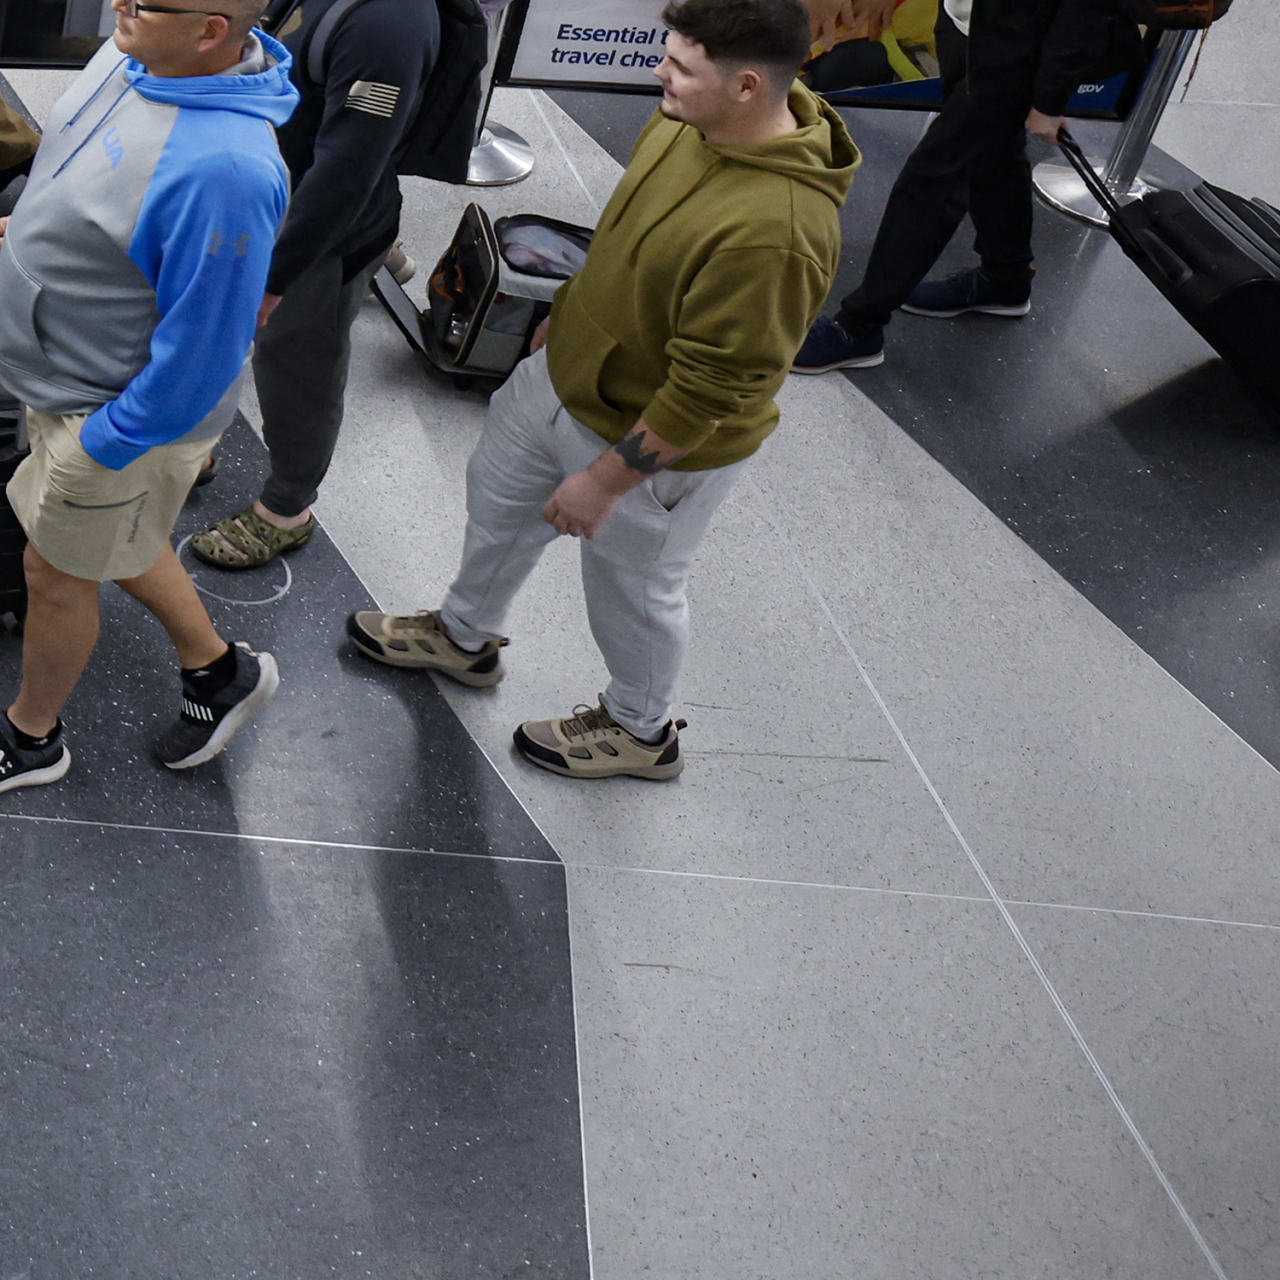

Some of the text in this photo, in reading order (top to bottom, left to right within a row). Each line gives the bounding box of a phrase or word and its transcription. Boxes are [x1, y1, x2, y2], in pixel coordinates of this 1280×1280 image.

[556, 23, 656, 45] Essential
[551, 47, 664, 68] travel che
